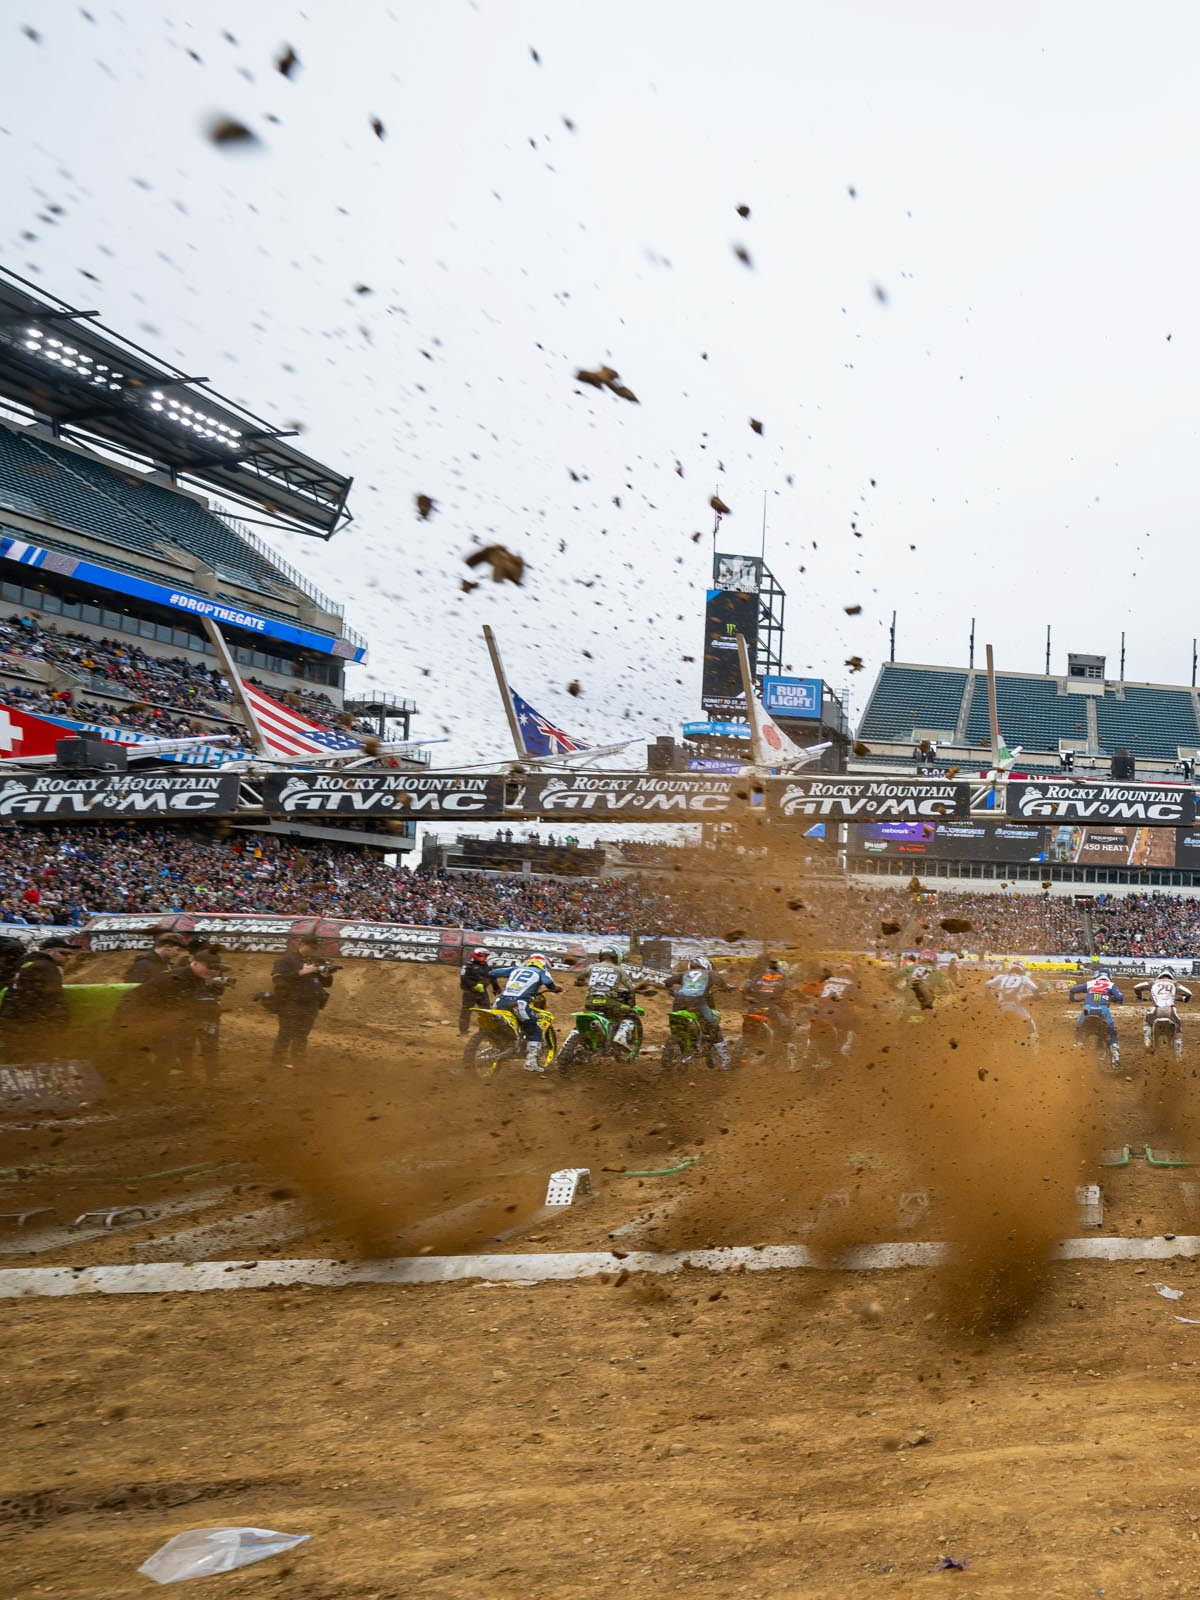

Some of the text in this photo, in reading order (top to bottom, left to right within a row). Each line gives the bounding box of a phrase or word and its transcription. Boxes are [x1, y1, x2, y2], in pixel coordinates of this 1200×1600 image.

[169, 593, 266, 631] #DROPTHEGATE
[777, 686, 807, 697] BUD
[770, 695, 812, 707] LIGHT
[31, 776, 222, 792] ROCKY MOUNTAIN
[313, 775, 488, 791] ROCKY MOUNTAIN
[571, 776, 731, 793] ROCKY MOUNTAIN
[808, 782, 957, 798] ROCKY MOUNTAIN
[1045, 785, 1183, 803] ROCKY MOUNTAIN
[1084, 843, 1100, 851] 450
[1102, 844, 1121, 852] HEAT
[513, 969, 536, 983] 12
[589, 972, 618, 986] 848
[1089, 979, 1110, 994] 2
